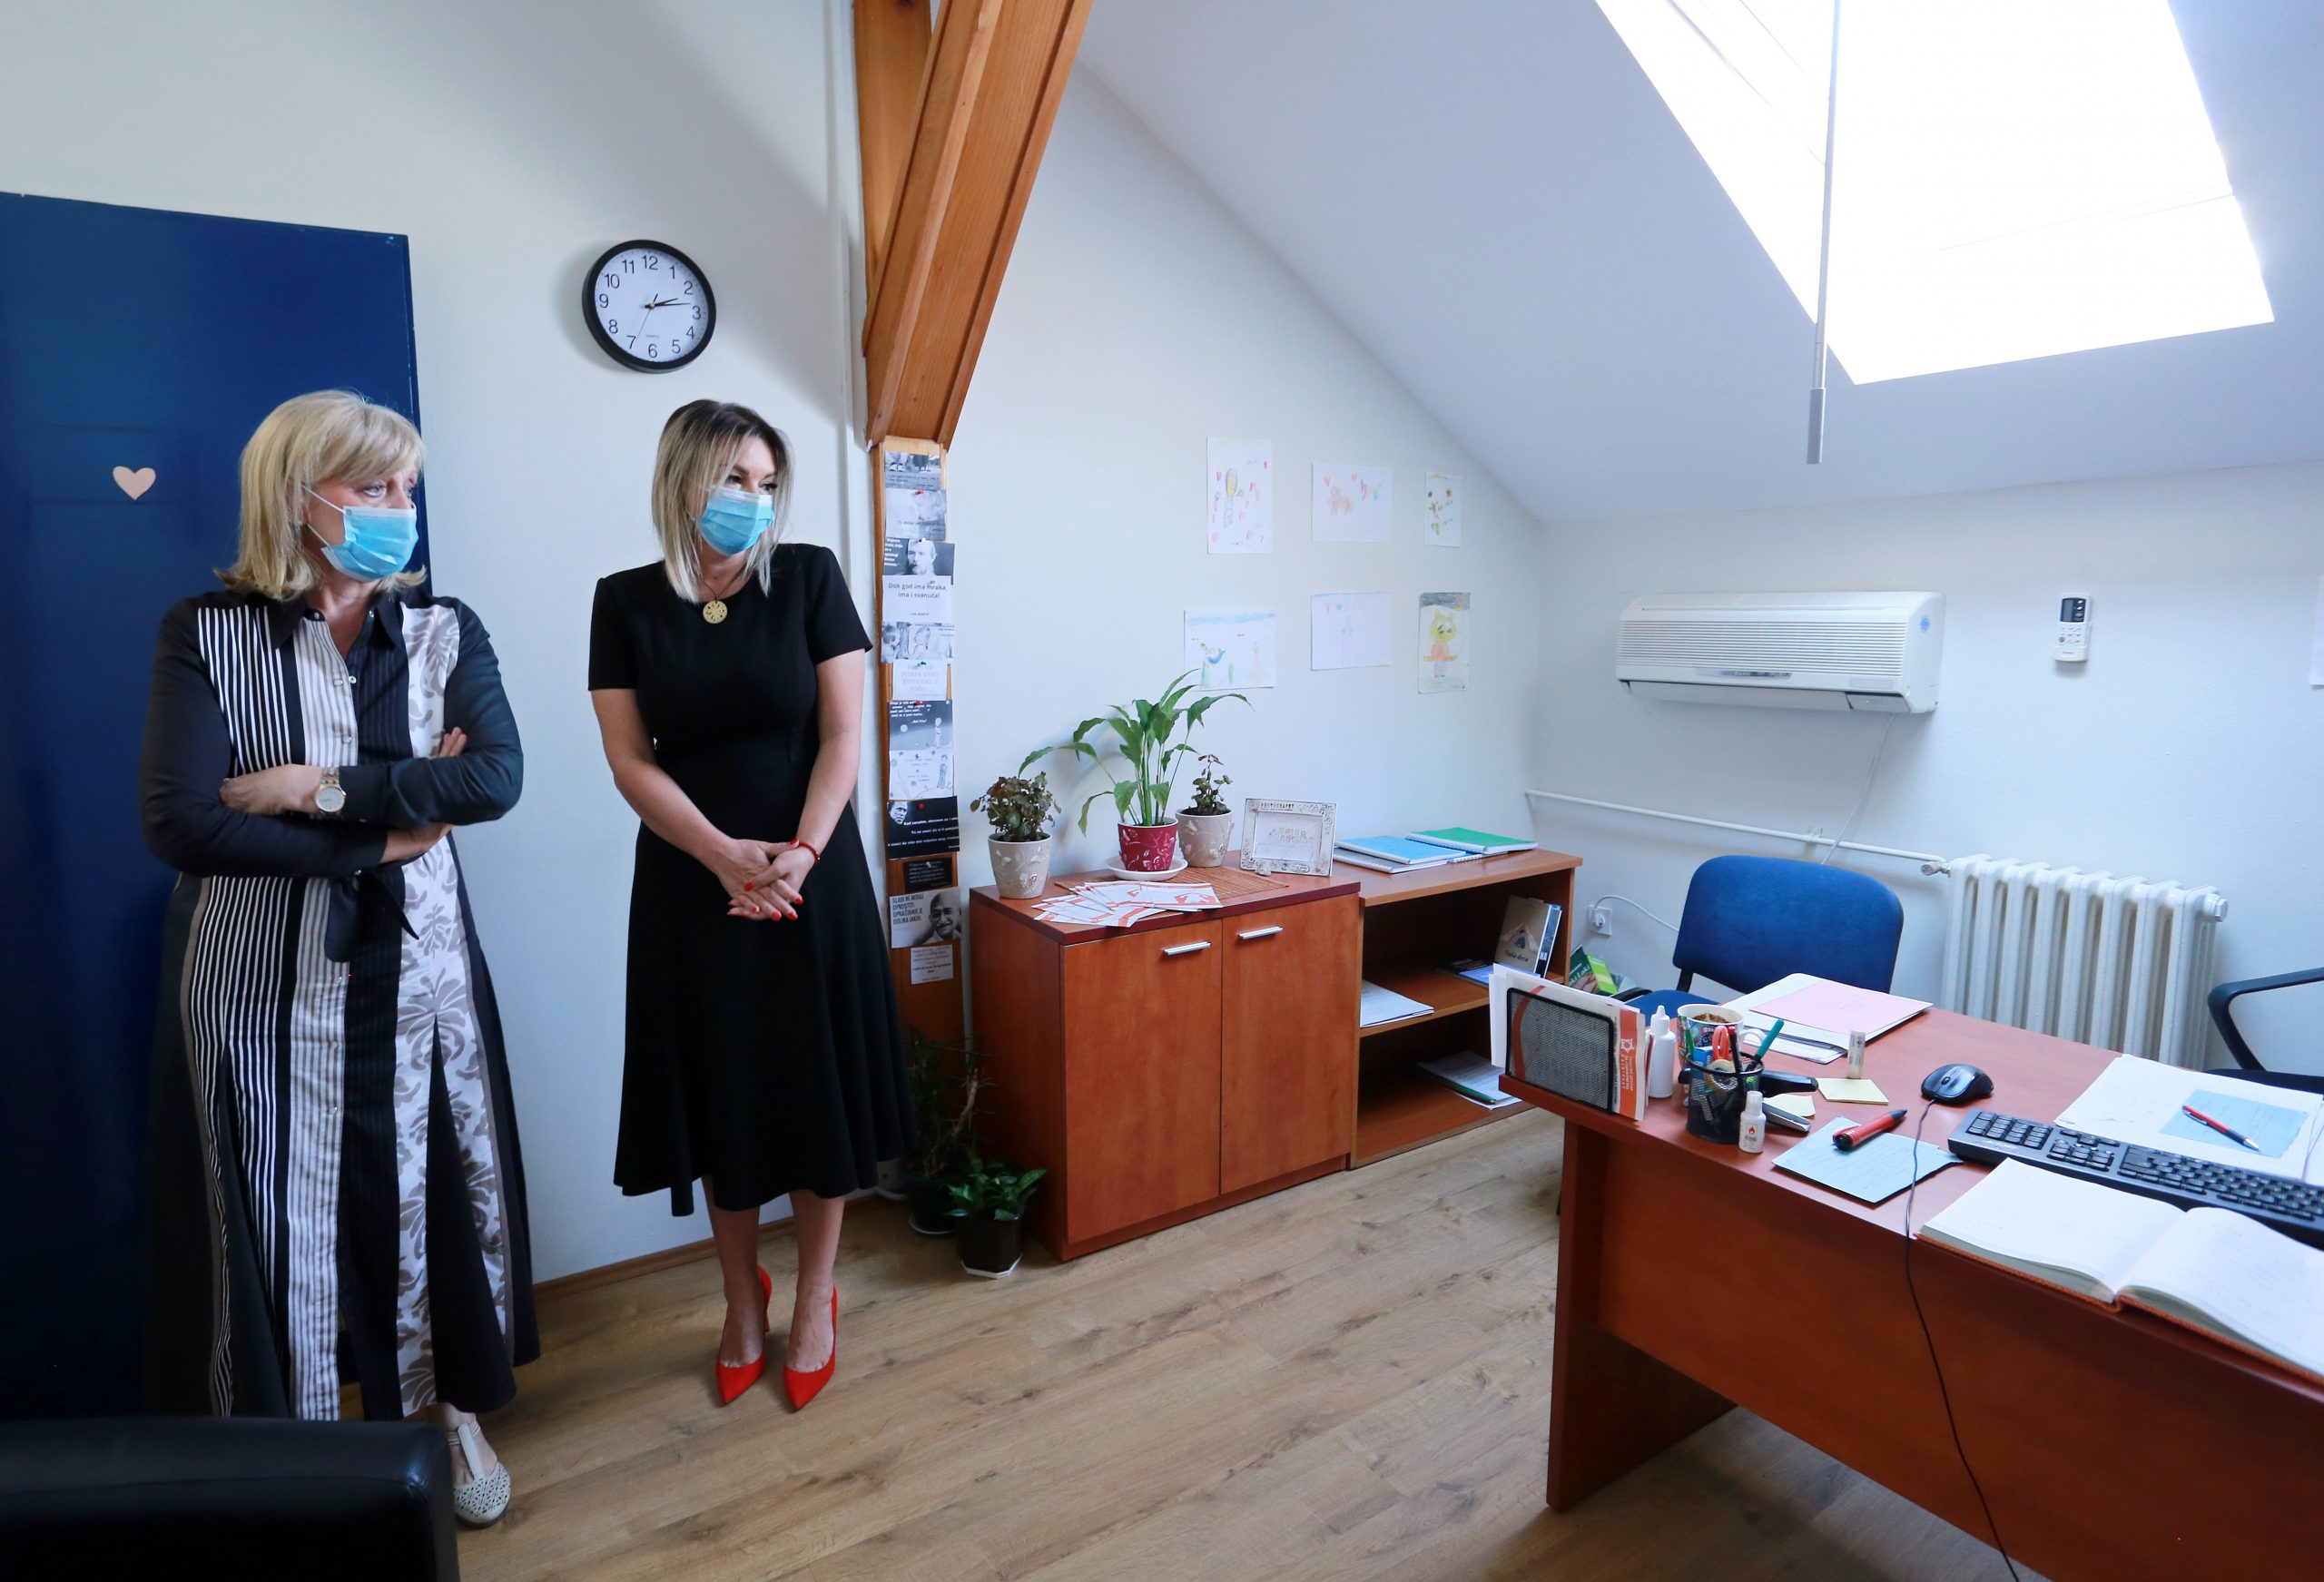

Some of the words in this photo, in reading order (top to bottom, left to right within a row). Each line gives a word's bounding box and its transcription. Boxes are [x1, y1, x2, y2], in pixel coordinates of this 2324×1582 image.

[622, 259, 635, 274] 11
[642, 255, 658, 270] 12
[669, 265, 675, 280] 1
[605, 273, 620, 289] 10
[684, 280, 694, 295] 2
[599, 293, 609, 309] 9
[692, 305, 702, 319] 3
[608, 319, 618, 334] 8
[685, 326, 694, 339] 4
[626, 335, 636, 349] 7
[672, 339, 681, 354] 5
[648, 343, 657, 358] 6
